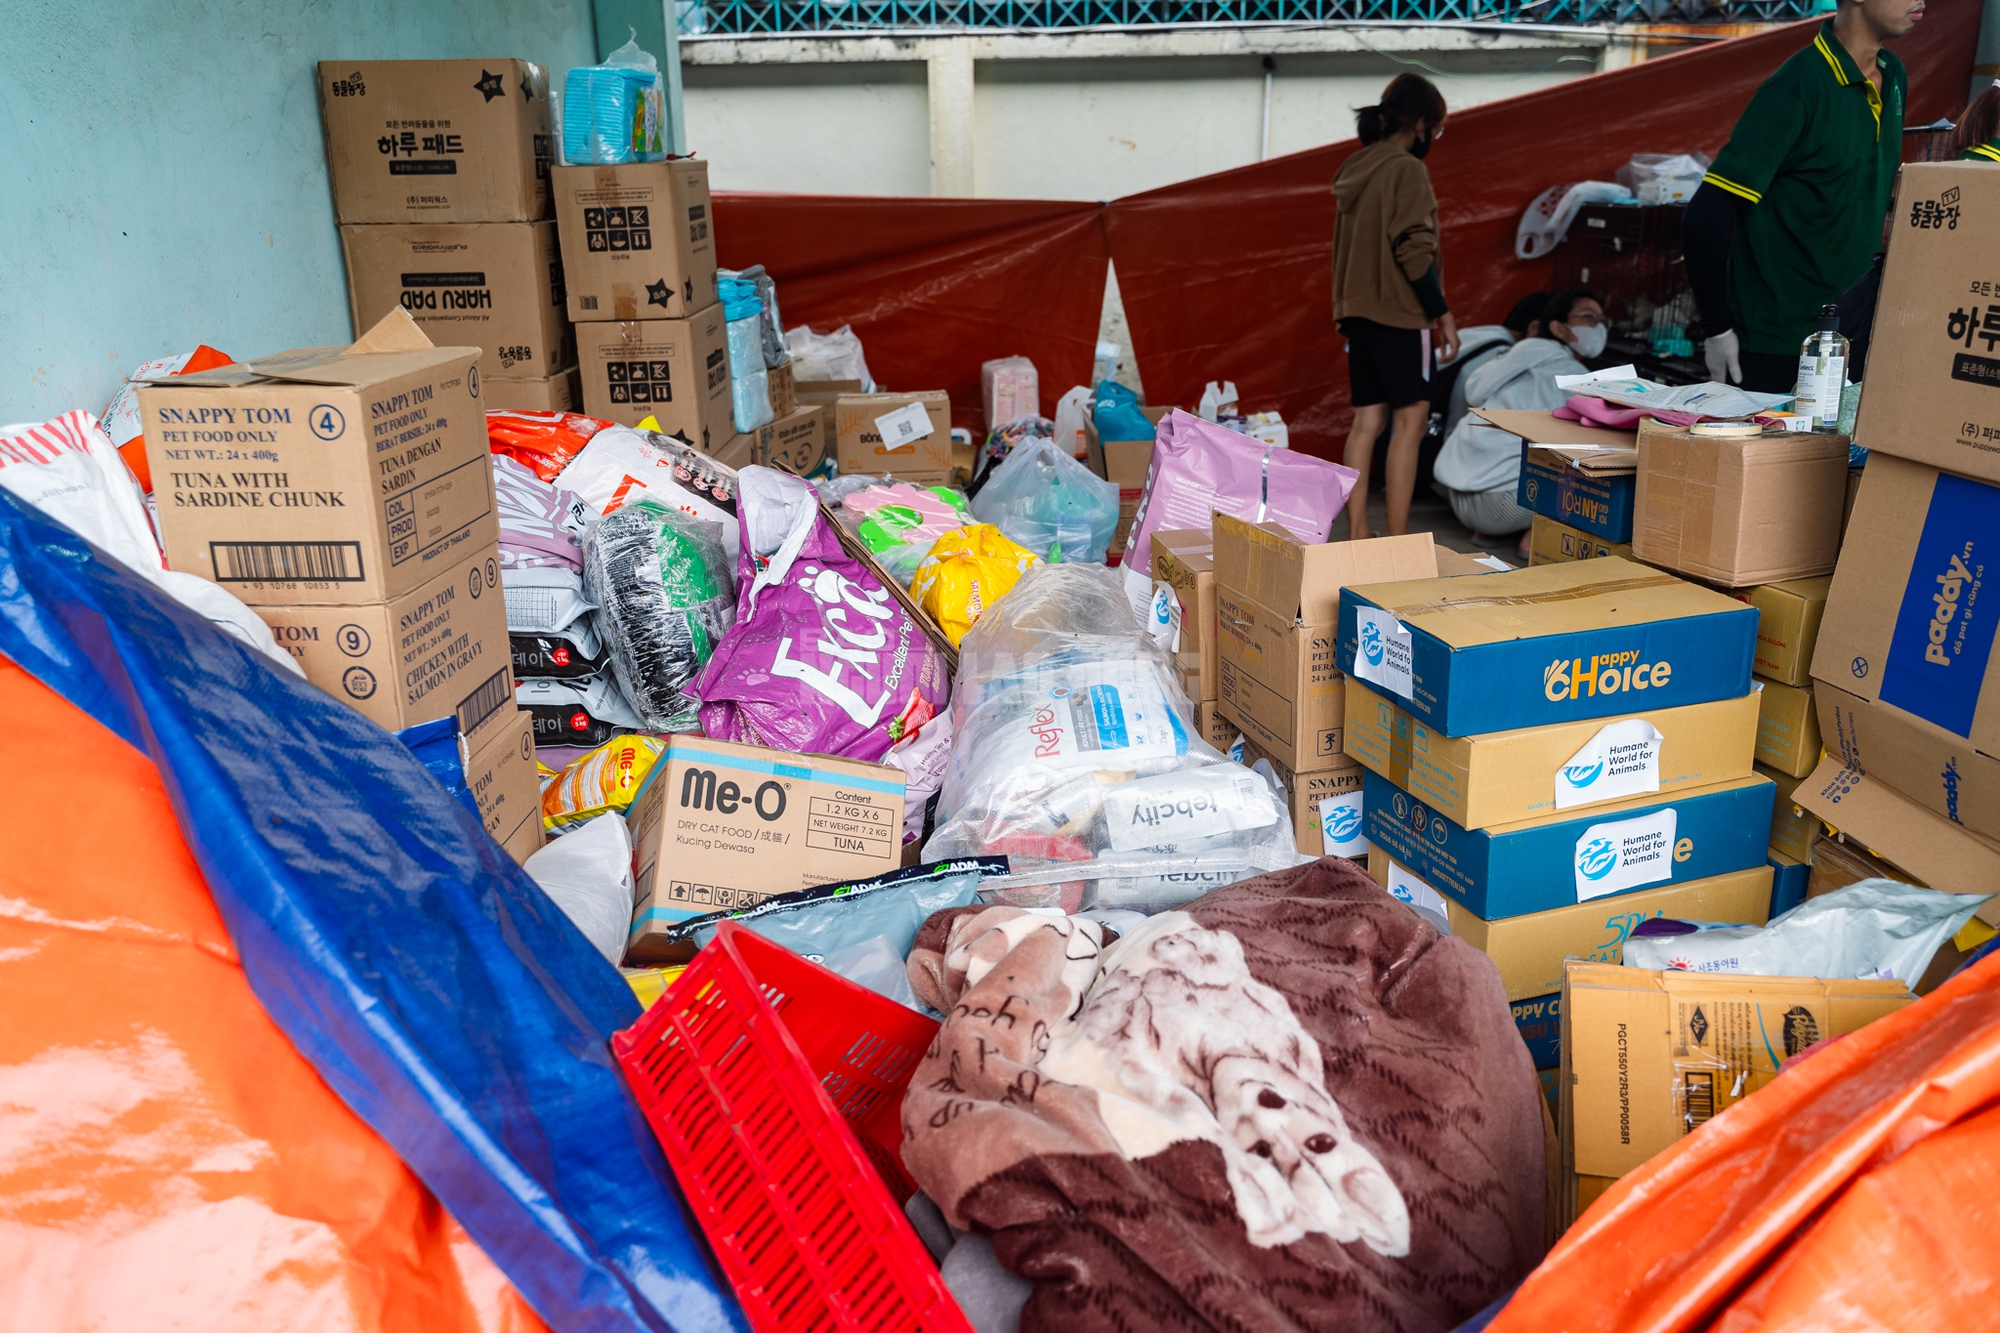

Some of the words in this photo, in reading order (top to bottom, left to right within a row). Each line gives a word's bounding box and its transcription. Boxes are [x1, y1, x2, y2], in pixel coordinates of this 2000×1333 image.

[377, 132, 419, 157] 하루
[422, 134, 464, 154] 패드
[1910, 200, 1960, 231] 동물농장
[1969, 281, 1991, 297] 모든
[401, 289, 437, 310] PAD
[442, 289, 492, 310] HARU
[428, 315, 460, 323] Companion
[371, 392, 410, 419] SNAPPY
[411, 384, 434, 402] TOM
[158, 408, 236, 424] SNAPPY
[242, 408, 292, 424] TOM
[319, 411, 336, 433] 4
[373, 421, 389, 437] PET
[389, 414, 410, 431] FOOD
[410, 407, 429, 425] ONLY
[162, 431, 189, 442] PET
[193, 431, 234, 442] FOOD
[237, 431, 277, 442] ONLY
[376, 435, 400, 453] BERAT
[166, 450, 191, 461] NET
[227, 450, 239, 460] 24
[252, 450, 280, 463] 400g
[379, 451, 407, 476] TUNA
[407, 437, 443, 464] DENGAN
[171, 473, 228, 488] TUNA
[232, 472, 290, 488] WITH
[381, 468, 417, 495] SARDIN
[175, 492, 264, 507] SARDINE
[269, 491, 346, 507] CHUNK
[388, 500, 406, 518] COL
[391, 518, 413, 539] PROD
[394, 541, 410, 560] EXP
[421, 543, 444, 563] PRODUCT
[450, 529, 472, 548] THAILAND
[400, 598, 434, 631] SNAPPY
[435, 585, 456, 608] TOM
[1925, 541, 1974, 667] paddy.vn
[272, 626, 320, 641] TOM
[402, 633, 416, 649] PET
[415, 620, 434, 641] FOOD
[434, 609, 451, 627] ONLY
[346, 631, 361, 650] 9
[1386, 636, 1410, 653] Humane
[403, 647, 417, 665] NET
[406, 650, 448, 688] CHICKEN
[447, 632, 470, 660] WITH
[1312, 652, 1331, 661] PET
[1386, 649, 1404, 664] World
[408, 669, 449, 706] SALMON
[447, 660, 457, 678] IN
[456, 640, 483, 670] GRAVY
[1311, 675, 1321, 683] 24
[1213, 723, 1228, 732] PET
[1213, 734, 1228, 742] NET
[1609, 741, 1649, 755] Humane
[1609, 753, 1637, 766] World
[1639, 750, 1653, 760] for
[475, 769, 494, 797] TOM
[1309, 774, 1363, 790] SNAPPY
[835, 790, 872, 804] Content
[1309, 792, 1327, 801] PET
[826, 804, 840, 814] 1.2
[844, 806, 859, 818] KG
[862, 808, 870, 819] X
[873, 810, 880, 821] 6
[1131, 793, 1218, 827] tebcity
[678, 819, 698, 832] DRY
[700, 822, 720, 834] CAT
[722, 826, 752, 839] FOOD
[813, 819, 828, 828] NET
[829, 821, 859, 833] WEIGHT
[861, 825, 874, 835] 7.2
[876, 827, 887, 838] KG
[676, 834, 712, 849] Kucing
[714, 840, 755, 855] Dewasa
[833, 836, 865, 852] TUNA
[1623, 831, 1662, 847] Humane
[1622, 844, 1650, 857] World
[1650, 840, 1667, 852] for
[949, 860, 979, 872] ADM
[849, 880, 882, 894] ADM
[1512, 1003, 1547, 1021] PPY
